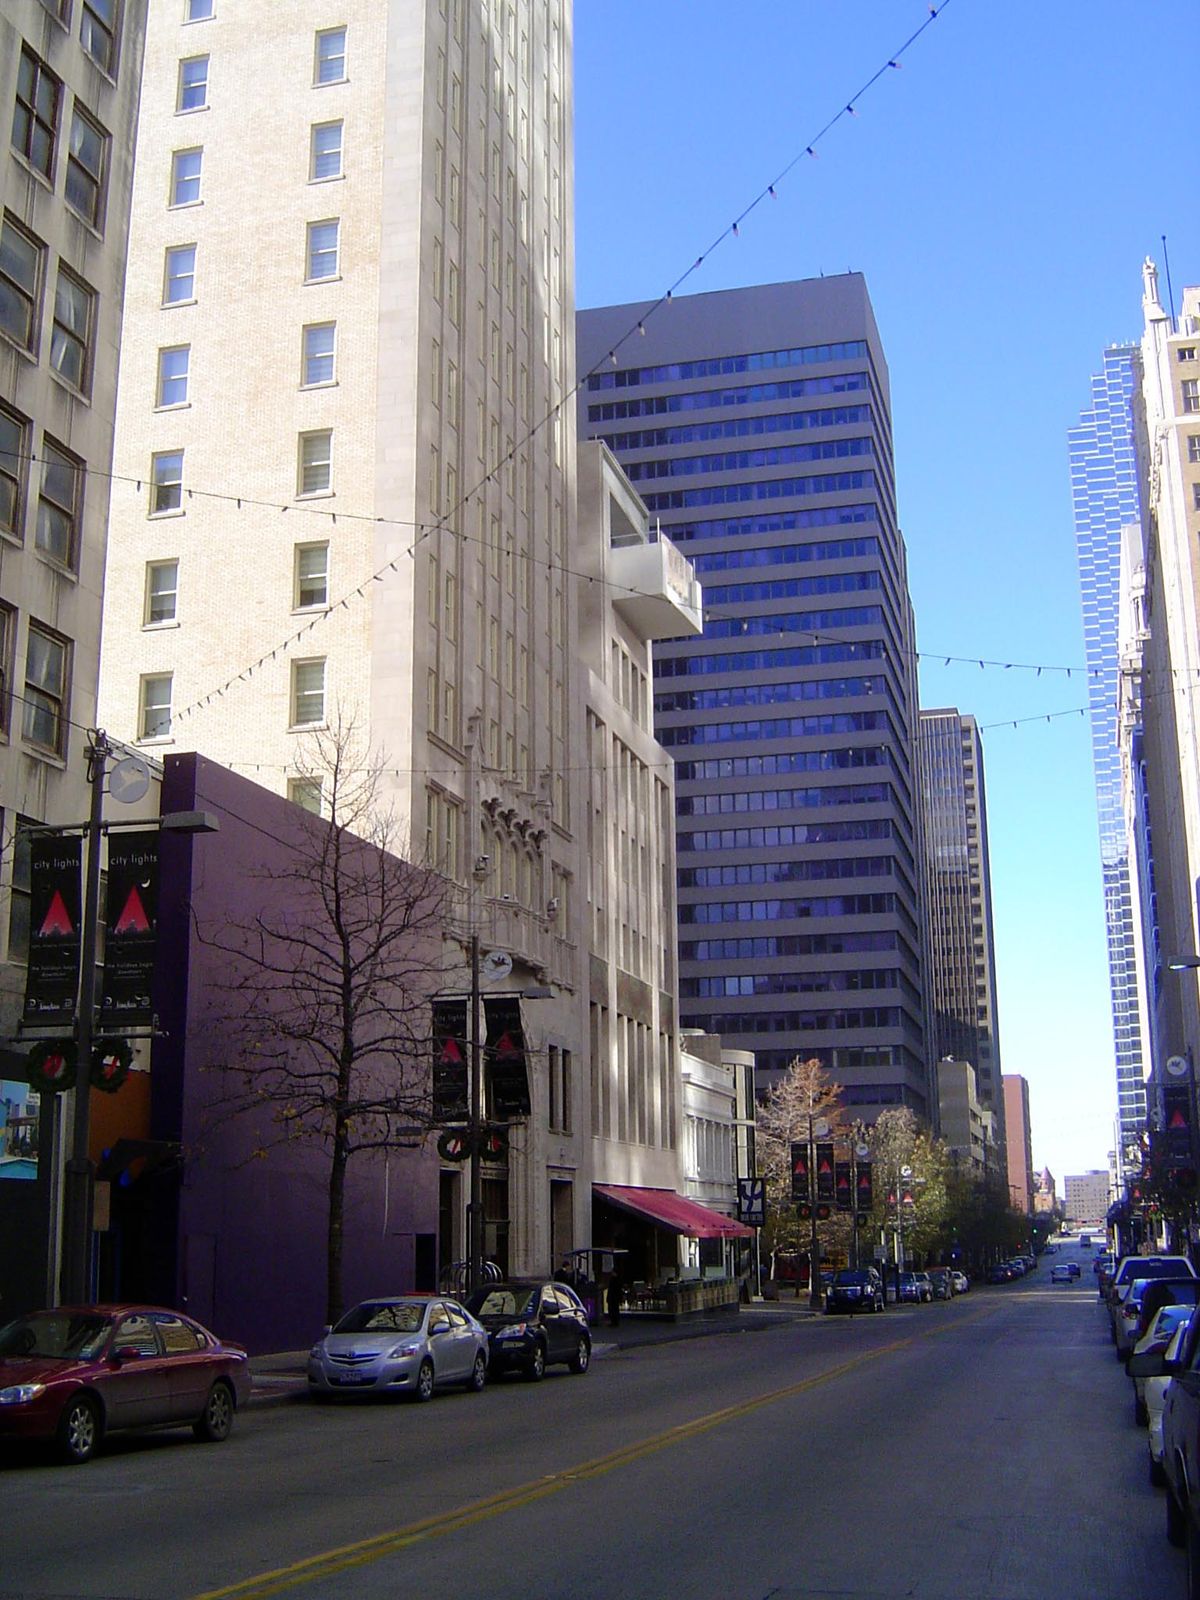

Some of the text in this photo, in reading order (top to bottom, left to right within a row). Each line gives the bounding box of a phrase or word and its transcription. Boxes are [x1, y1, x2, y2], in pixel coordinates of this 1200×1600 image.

[34, 857, 80, 870] city lights
[110, 852, 158, 866] city lights
